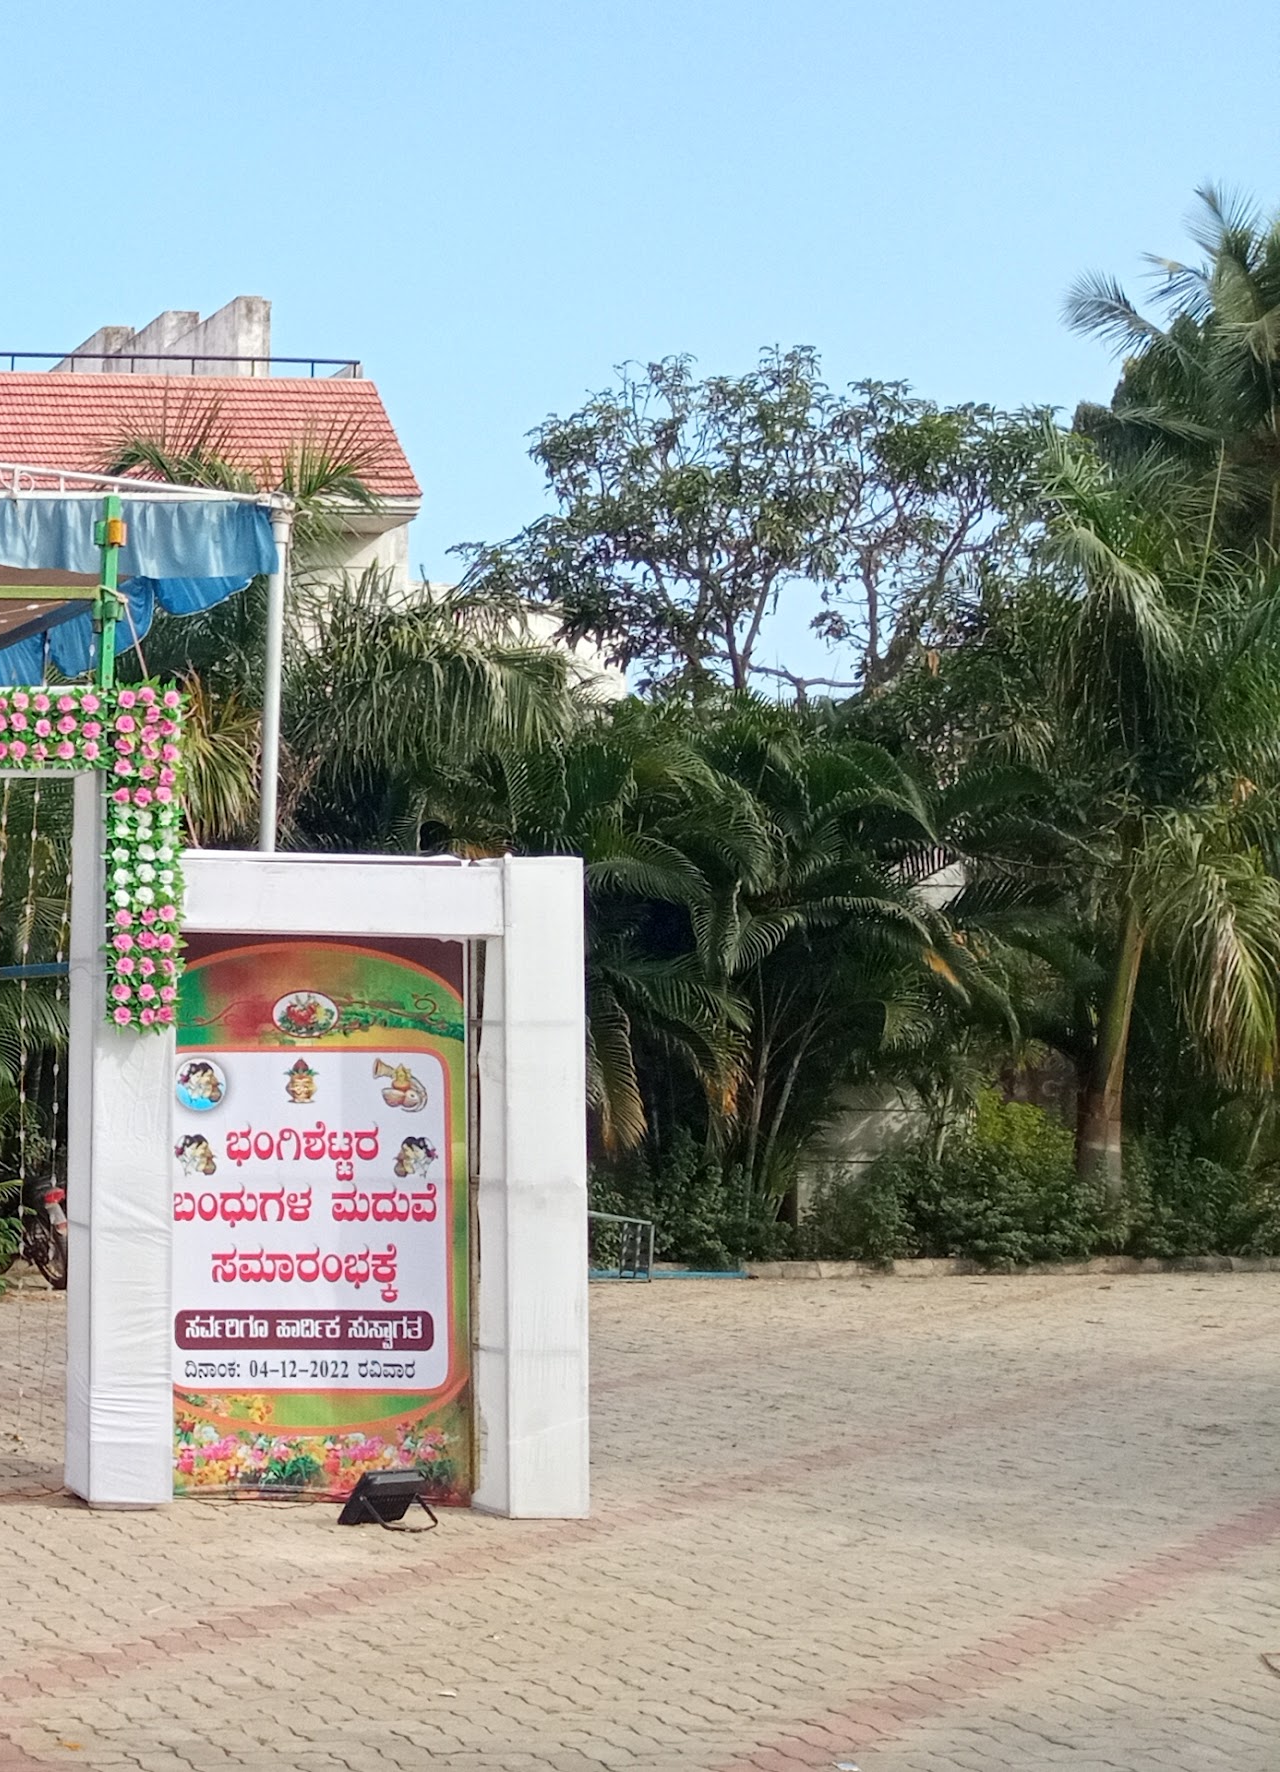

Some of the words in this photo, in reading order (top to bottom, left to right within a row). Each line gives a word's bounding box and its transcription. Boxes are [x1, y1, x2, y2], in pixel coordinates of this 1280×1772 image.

[226, 1120, 380, 1181] ಭಂಗಿಶೆಟ್ಟರ
[173, 1182, 312, 1228] ಬಂಧುಗಳ
[331, 1182, 438, 1222] ಮದುವೆ
[211, 1243, 398, 1303] ಸಮಾರಂಭಕ್ಕೆ
[185, 1315, 269, 1339] ಸರ್ವರಿಗೂ
[276, 1315, 341, 1339] ಹಾರ್ದಿಕ
[347, 1315, 423, 1350] ಸುಸ್ವಾಗತ
[249, 1360, 349, 1379] 04-12-2022
[357, 1360, 416, 1379] ರವಿವಾರ
